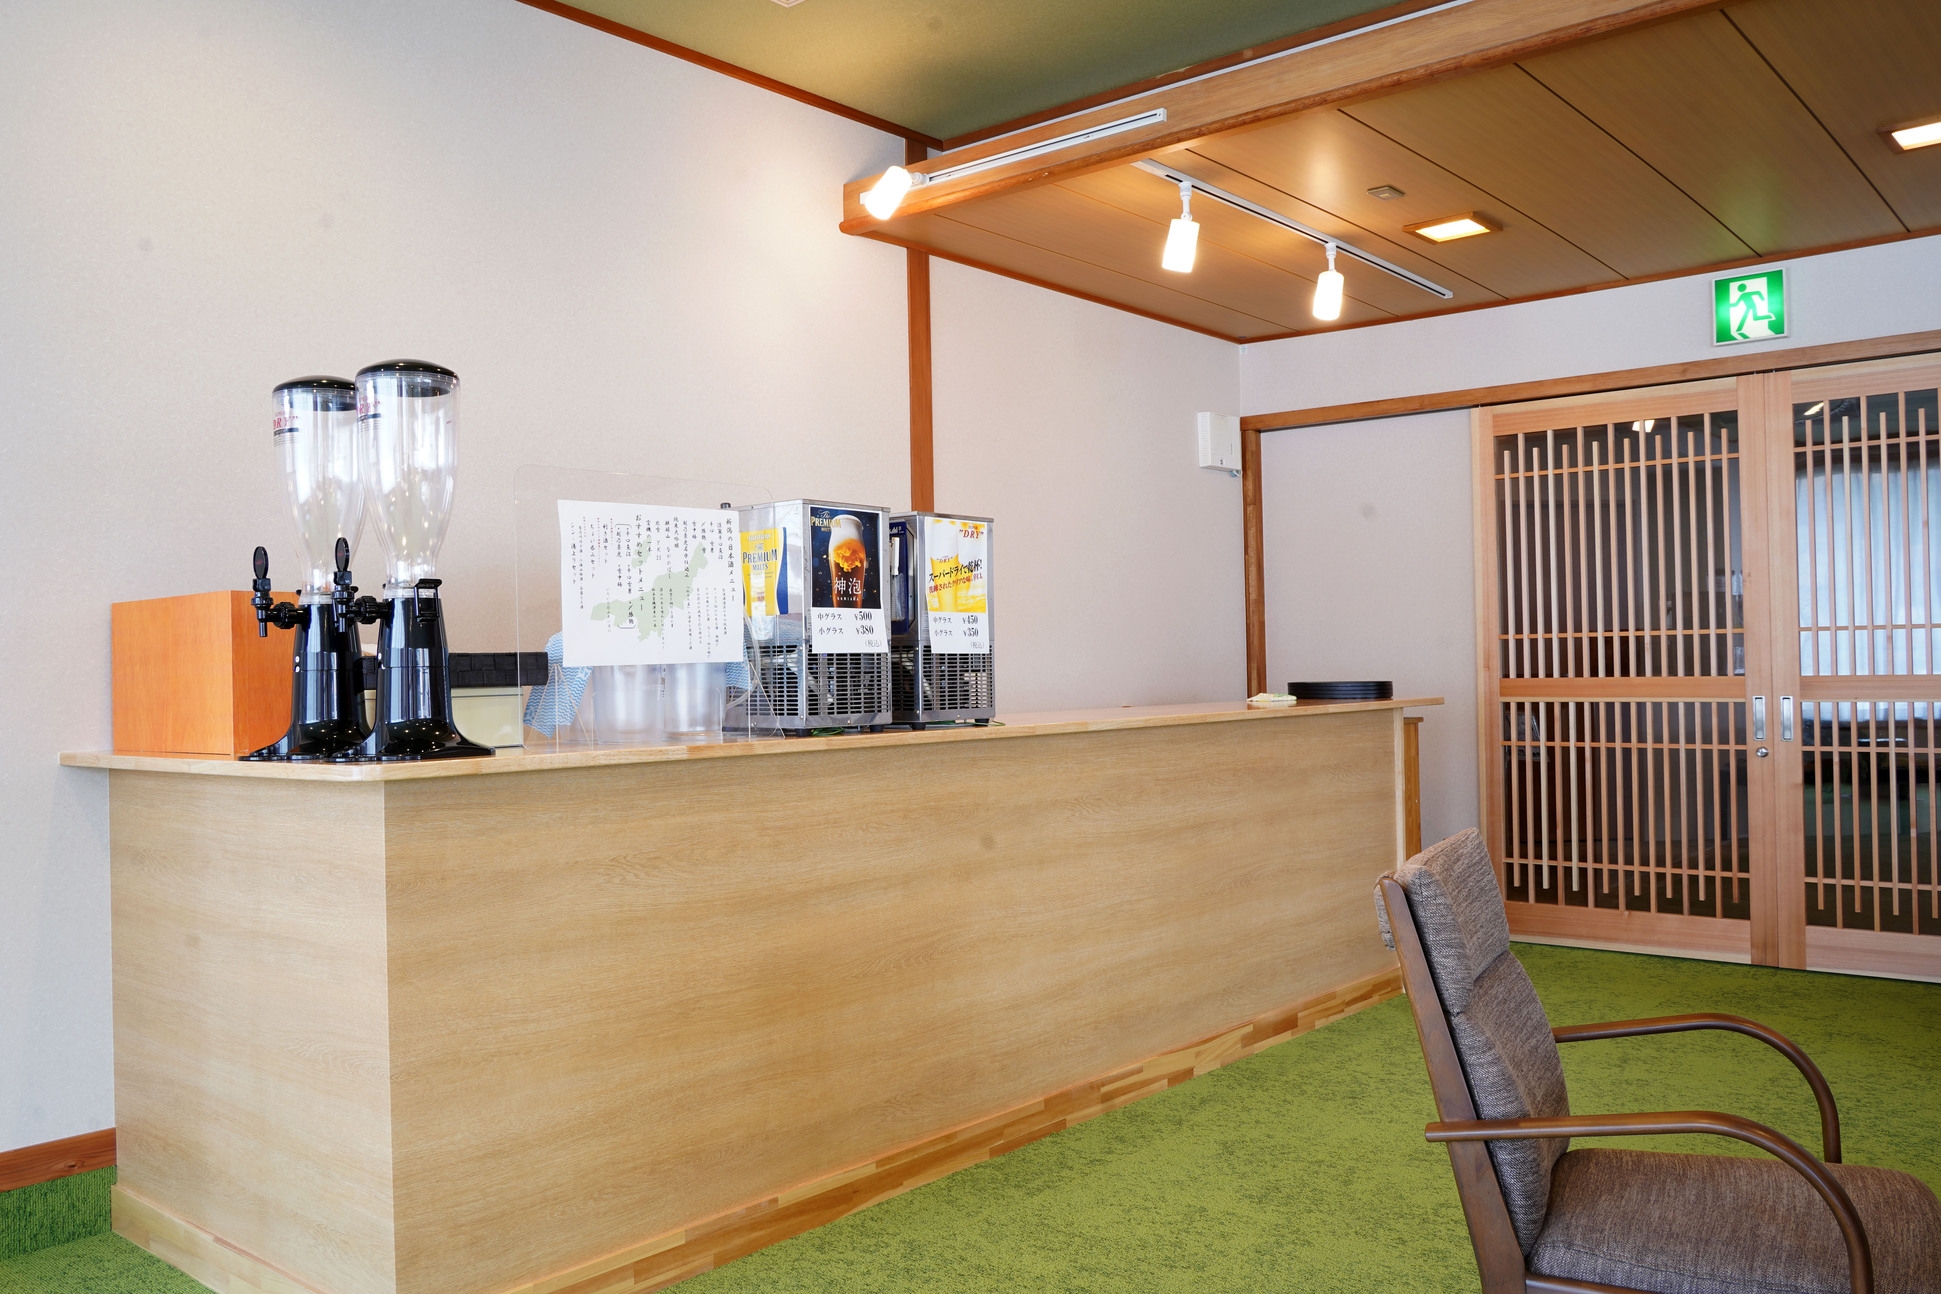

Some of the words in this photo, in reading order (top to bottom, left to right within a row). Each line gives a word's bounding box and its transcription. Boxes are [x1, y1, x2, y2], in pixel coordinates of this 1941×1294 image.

[811, 516, 842, 529] PREMIUM
[726, 518, 736, 602] 新潟の日本酒メニュー
[742, 548, 778, 564] PREMIUM
[635, 514, 645, 612] おすすめセットメニュー
[833, 577, 862, 594] 神泡
[817, 612, 843, 621] 中グラス
[854, 610, 873, 621] ¥500
[961, 614, 979, 624] ¥450
[818, 626, 844, 635] 小グラス
[855, 624, 874, 635] ¥380
[962, 627, 979, 637] ¥350
